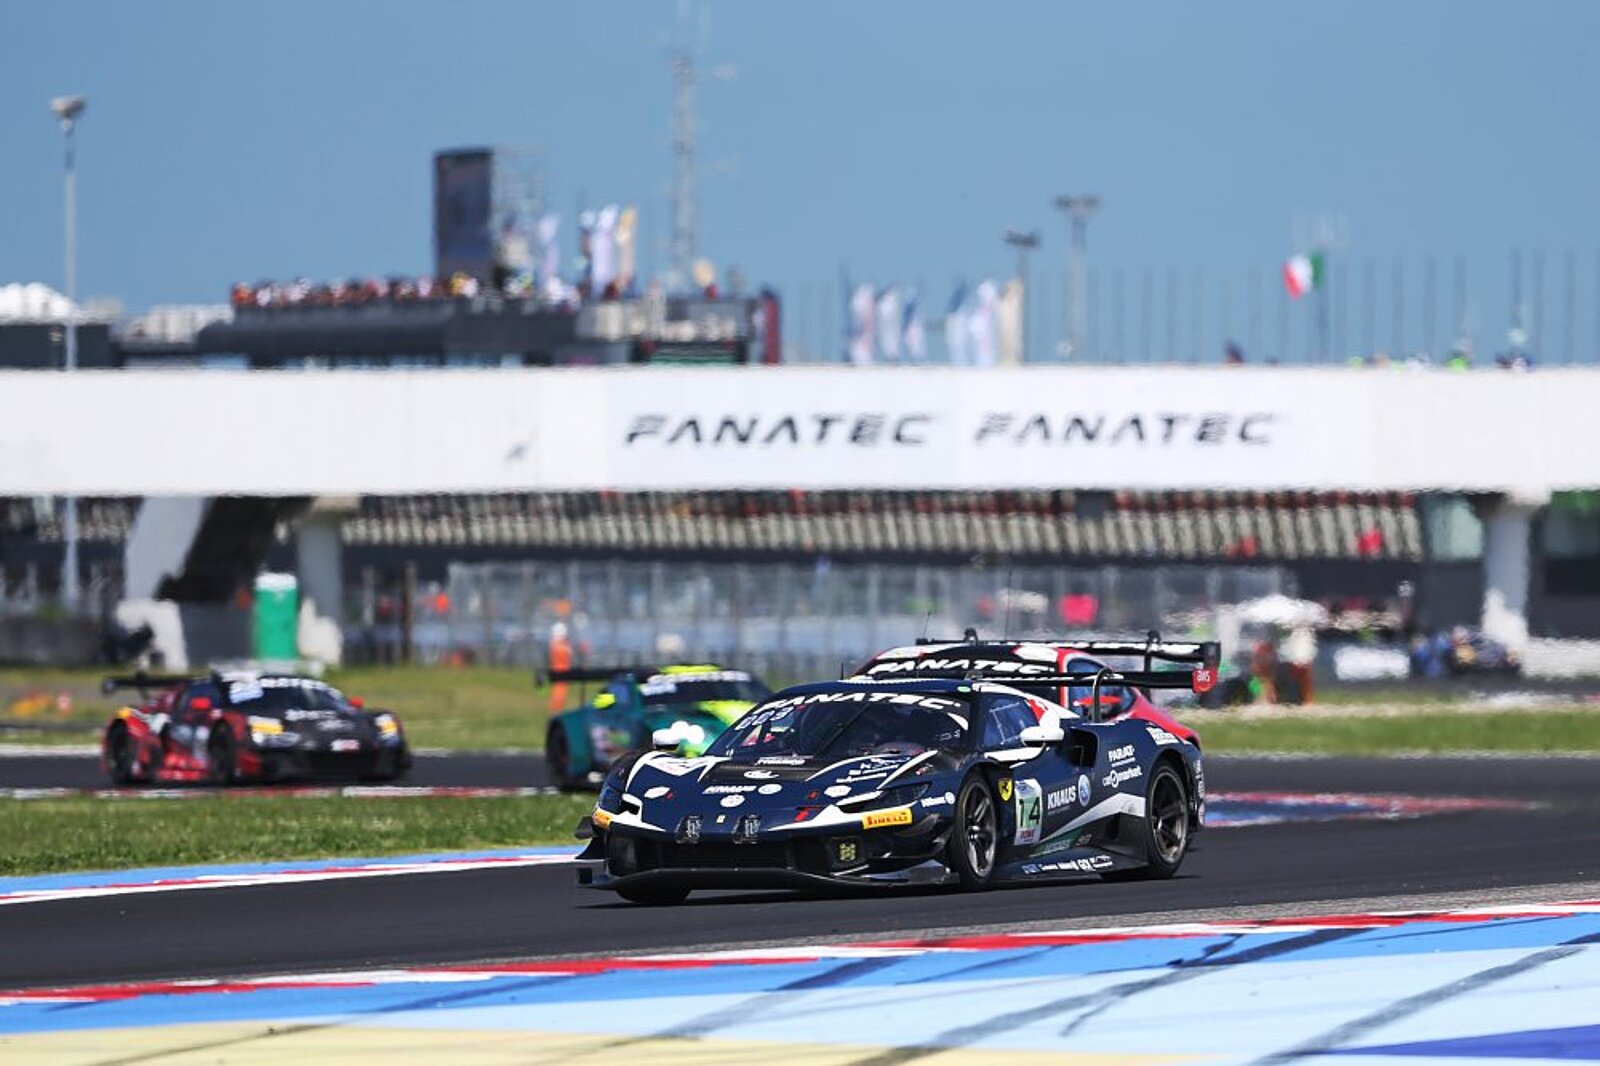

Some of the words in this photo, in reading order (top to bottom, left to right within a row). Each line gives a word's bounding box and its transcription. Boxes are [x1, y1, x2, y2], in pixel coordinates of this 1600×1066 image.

[624, 411, 932, 446] FANATEC
[971, 410, 1277, 445] FANATEC
[867, 657, 1048, 675] FANATEC
[753, 692, 955, 713] FANATEC
[1047, 785, 1077, 810] KNAUS
[866, 814, 909, 827] PIRELLI
[1018, 796, 1041, 828] 14
